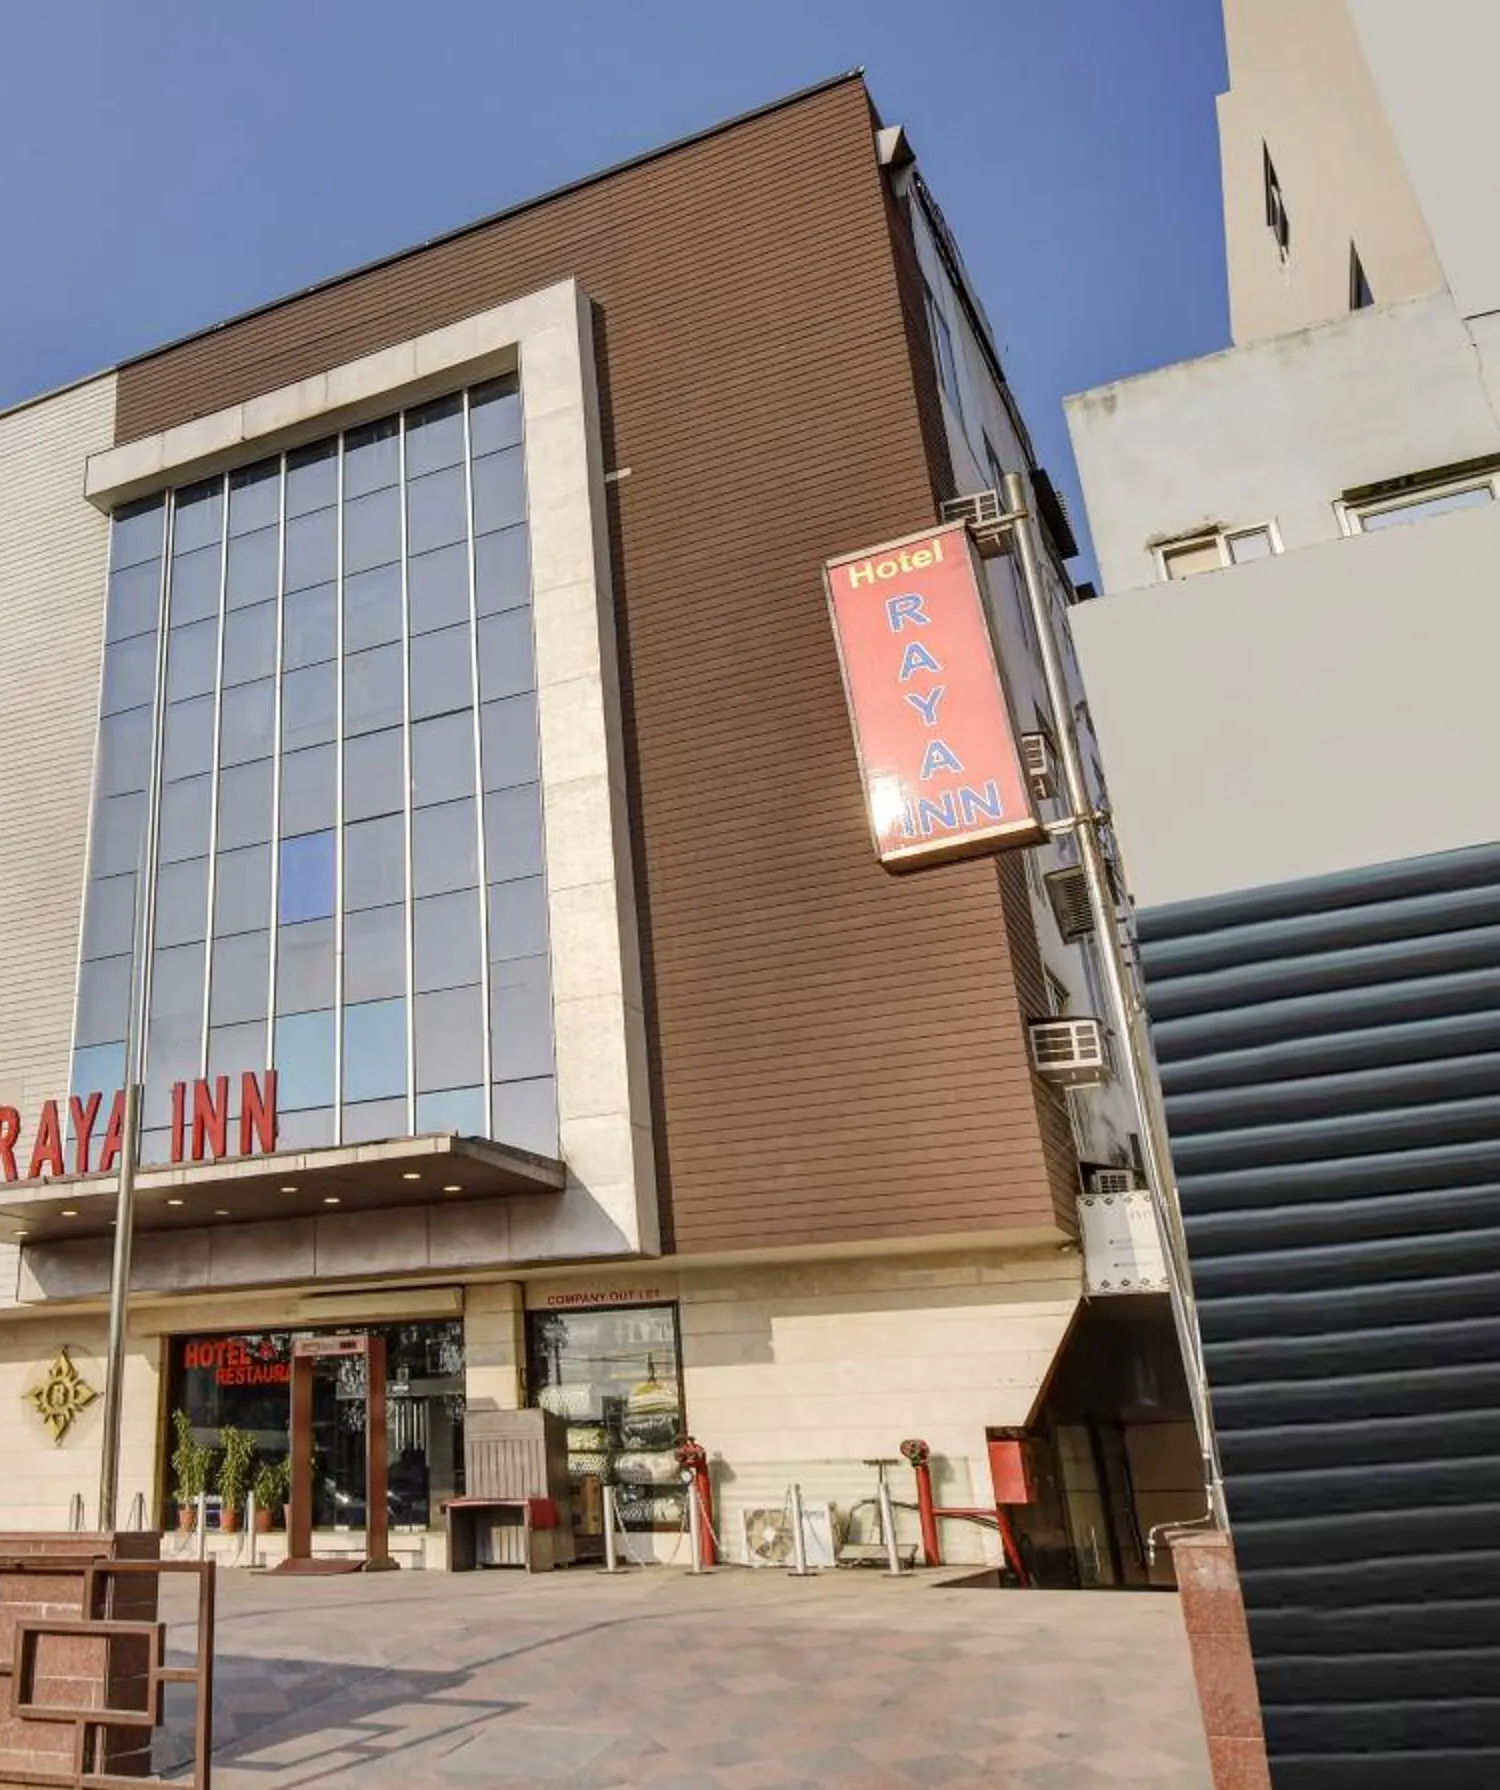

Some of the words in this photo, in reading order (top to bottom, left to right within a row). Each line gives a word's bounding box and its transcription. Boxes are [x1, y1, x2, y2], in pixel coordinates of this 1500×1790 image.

[847, 538, 945, 590] Hotel
[885, 592, 964, 781] RAYA
[900, 778, 1004, 837] INN
[170, 1069, 278, 1164] INN
[547, 1291, 606, 1305] COMPANY
[184, 1341, 252, 1370] HOTEL
[215, 1363, 291, 1386] RESTAURA
